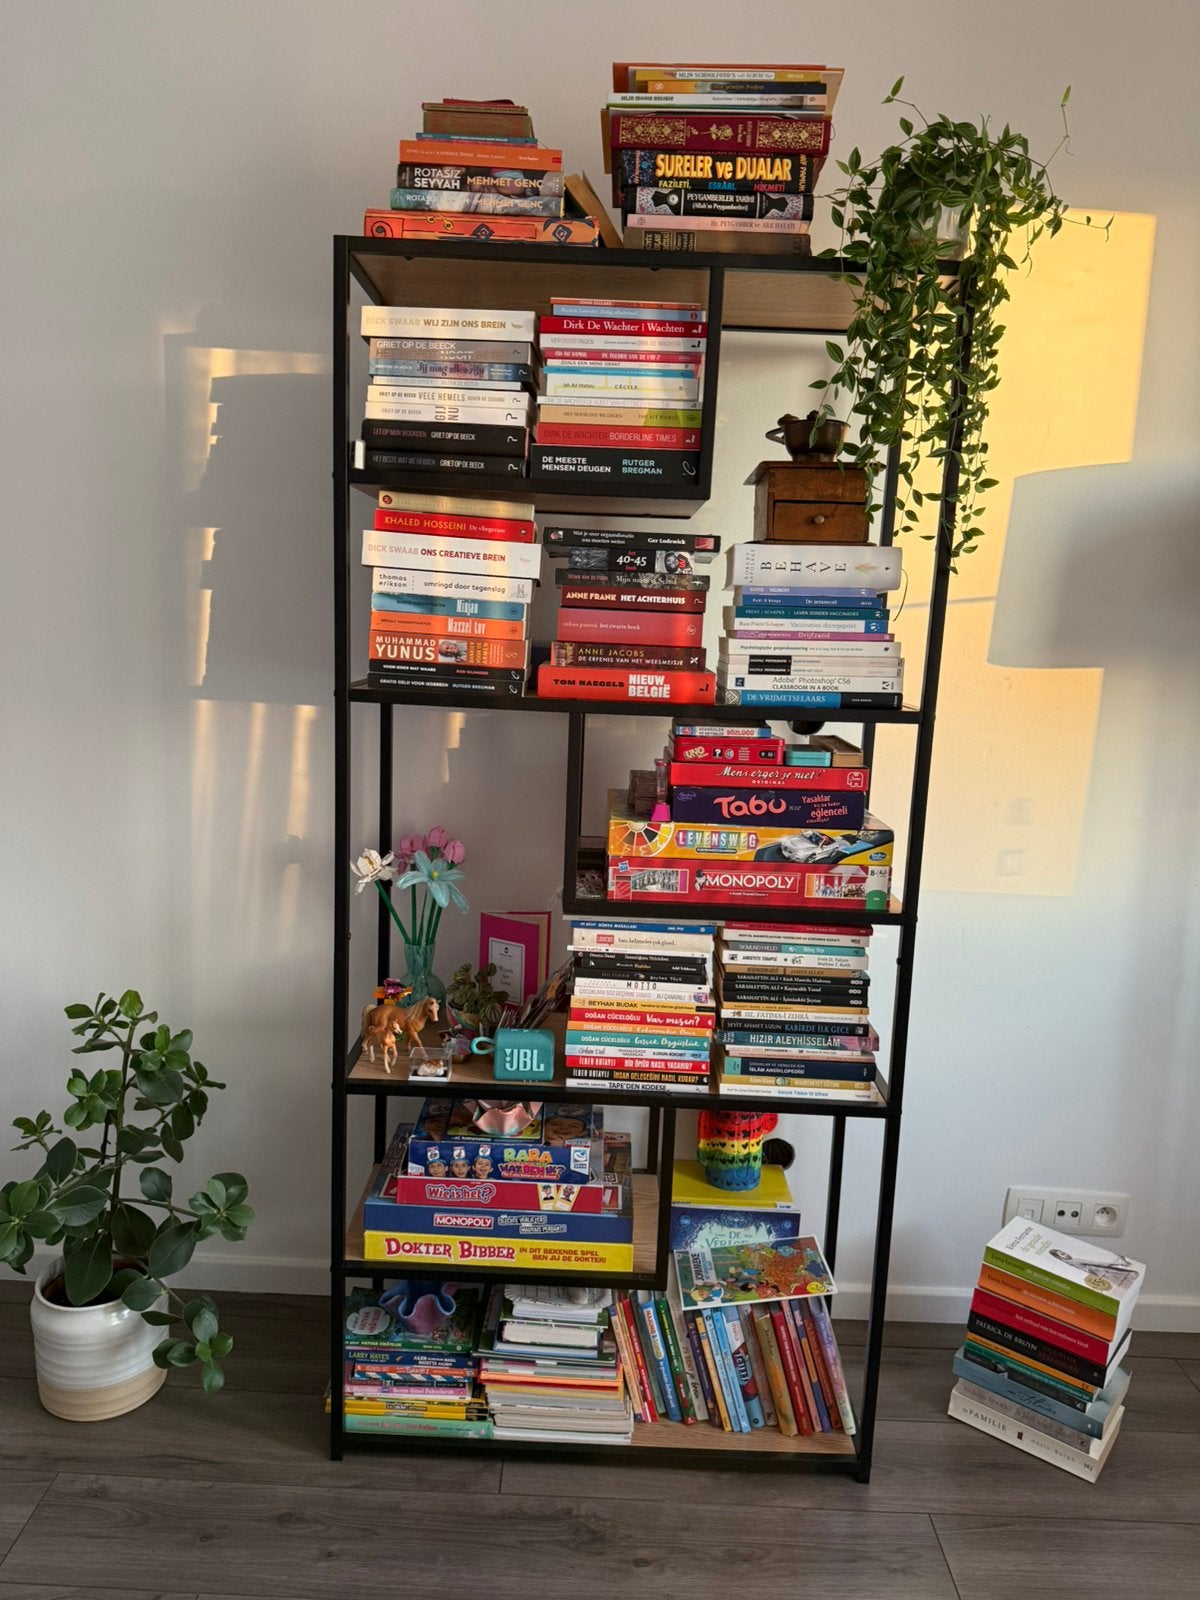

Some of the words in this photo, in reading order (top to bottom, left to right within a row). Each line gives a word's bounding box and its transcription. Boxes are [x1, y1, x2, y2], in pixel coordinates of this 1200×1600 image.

[414, 167, 461, 178] ROTASIZ
[656, 155, 713, 178] SURELER
[716, 162, 733, 180] ve
[735, 157, 791, 182] DUALAR
[414, 177, 460, 189] SEYYAH
[474, 198, 514, 207] MEHMET
[687, 193, 734, 202] PEYGAMBERLER
[366, 317, 386, 325] DICK
[389, 318, 420, 326] SWAAB
[423, 319, 439, 327] WIJ
[481, 321, 506, 329] BREIN
[563, 320, 584, 330] Dirk
[588, 320, 600, 330] De
[603, 321, 639, 332] Wachter
[648, 322, 684, 333] Wachten
[377, 341, 400, 349] GRIET
[402, 341, 414, 349] OP
[429, 342, 456, 350] BEECK
[418, 391, 436, 400] VELE
[438, 392, 466, 402] HEMELS
[447, 407, 459, 421] NU
[543, 430, 561, 438] DIRK
[574, 431, 608, 440] WACHTER
[609, 433, 653, 442] BORDERLINE
[656, 434, 677, 442] TIMES
[577, 465, 611, 473] DEUGEN
[622, 459, 655, 467] RUTGER
[622, 467, 662, 475] BREGMAN
[385, 516, 420, 527] KHALED
[424, 518, 466, 531] HOSSEINI
[368, 543, 387, 552] DICK
[389, 545, 419, 555] SWAAB
[421, 548, 437, 557] ONS
[439, 550, 481, 560] CREATIEVE
[483, 553, 506, 562] BREIN
[617, 555, 647, 567] 40-45
[760, 560, 847, 572] BEHAVE
[379, 573, 407, 582] thomas
[379, 580, 407, 588] erikson
[424, 580, 453, 589] omringd
[454, 582, 470, 590] door
[472, 584, 506, 594] tegenslag
[566, 592, 588, 600] ANNE
[589, 592, 617, 601] FRANK
[621, 594, 635, 602] HET
[637, 595, 685, 605] ACHTERHUIS
[376, 636, 436, 647] MUHAMMAD
[376, 644, 435, 661] YUNUS
[608, 649, 644, 657] JACOBS
[579, 680, 625, 688] NAEGELS
[628, 674, 665, 685] NIEUW
[628, 685, 670, 698] BELGIË
[747, 693, 758, 701] DE
[759, 693, 826, 703] VRIJMETSELAARS
[683, 746, 705, 759] UNO
[716, 766, 748, 777] Mens
[750, 768, 781, 778] erger
[782, 769, 791, 779] je
[801, 795, 831, 804] Yasaklar
[810, 805, 848, 818] eğlenceli
[677, 831, 757, 849] LEVENSWEG
[708, 874, 795, 890] MONOPOLY
[626, 982, 657, 990] MOTTO
[607, 1013, 641, 1021] CÜCELOĞLU
[646, 1015, 664, 1023] Var
[785, 1024, 816, 1032] KABİRDE
[818, 1024, 829, 1033] İLK
[831, 1026, 849, 1034] GECE
[750, 1034, 773, 1043] HIZIR
[776, 1035, 841, 1047] ALEYHİSSELÂM
[505, 1049, 545, 1071] JBL
[579, 1057, 594, 1065] İLBER
[596, 1058, 616, 1066] ORTAYLI
[635, 1060, 649, 1068] ÖMÜR
[573, 1069, 588, 1077] İLBER
[589, 1070, 609, 1078] ORTAYLI
[661, 1074, 677, 1082] NASIL
[678, 1075, 699, 1083] KURAR?
[503, 1148, 553, 1163] RARA
[426, 1184, 448, 1198] Wie
[450, 1185, 461, 1199] is
[462, 1184, 495, 1202] het?
[435, 1216, 492, 1227] MONOPOLY
[729, 1231, 741, 1239] DE
[384, 1238, 451, 1263] DOKTER
[458, 1241, 516, 1260] BIBBER
[543, 1248, 578, 1256] BEKENDE
[532, 1254, 548, 1262] BEN
[975, 1319, 1003, 1338] PATRICK
[1003, 1331, 1013, 1341] DE
[1014, 1335, 1037, 1351] BRUYN
[349, 1352, 368, 1360] LARRY
[369, 1352, 390, 1361] HAYES
[968, 1407, 1008, 1432] FAMILIE
